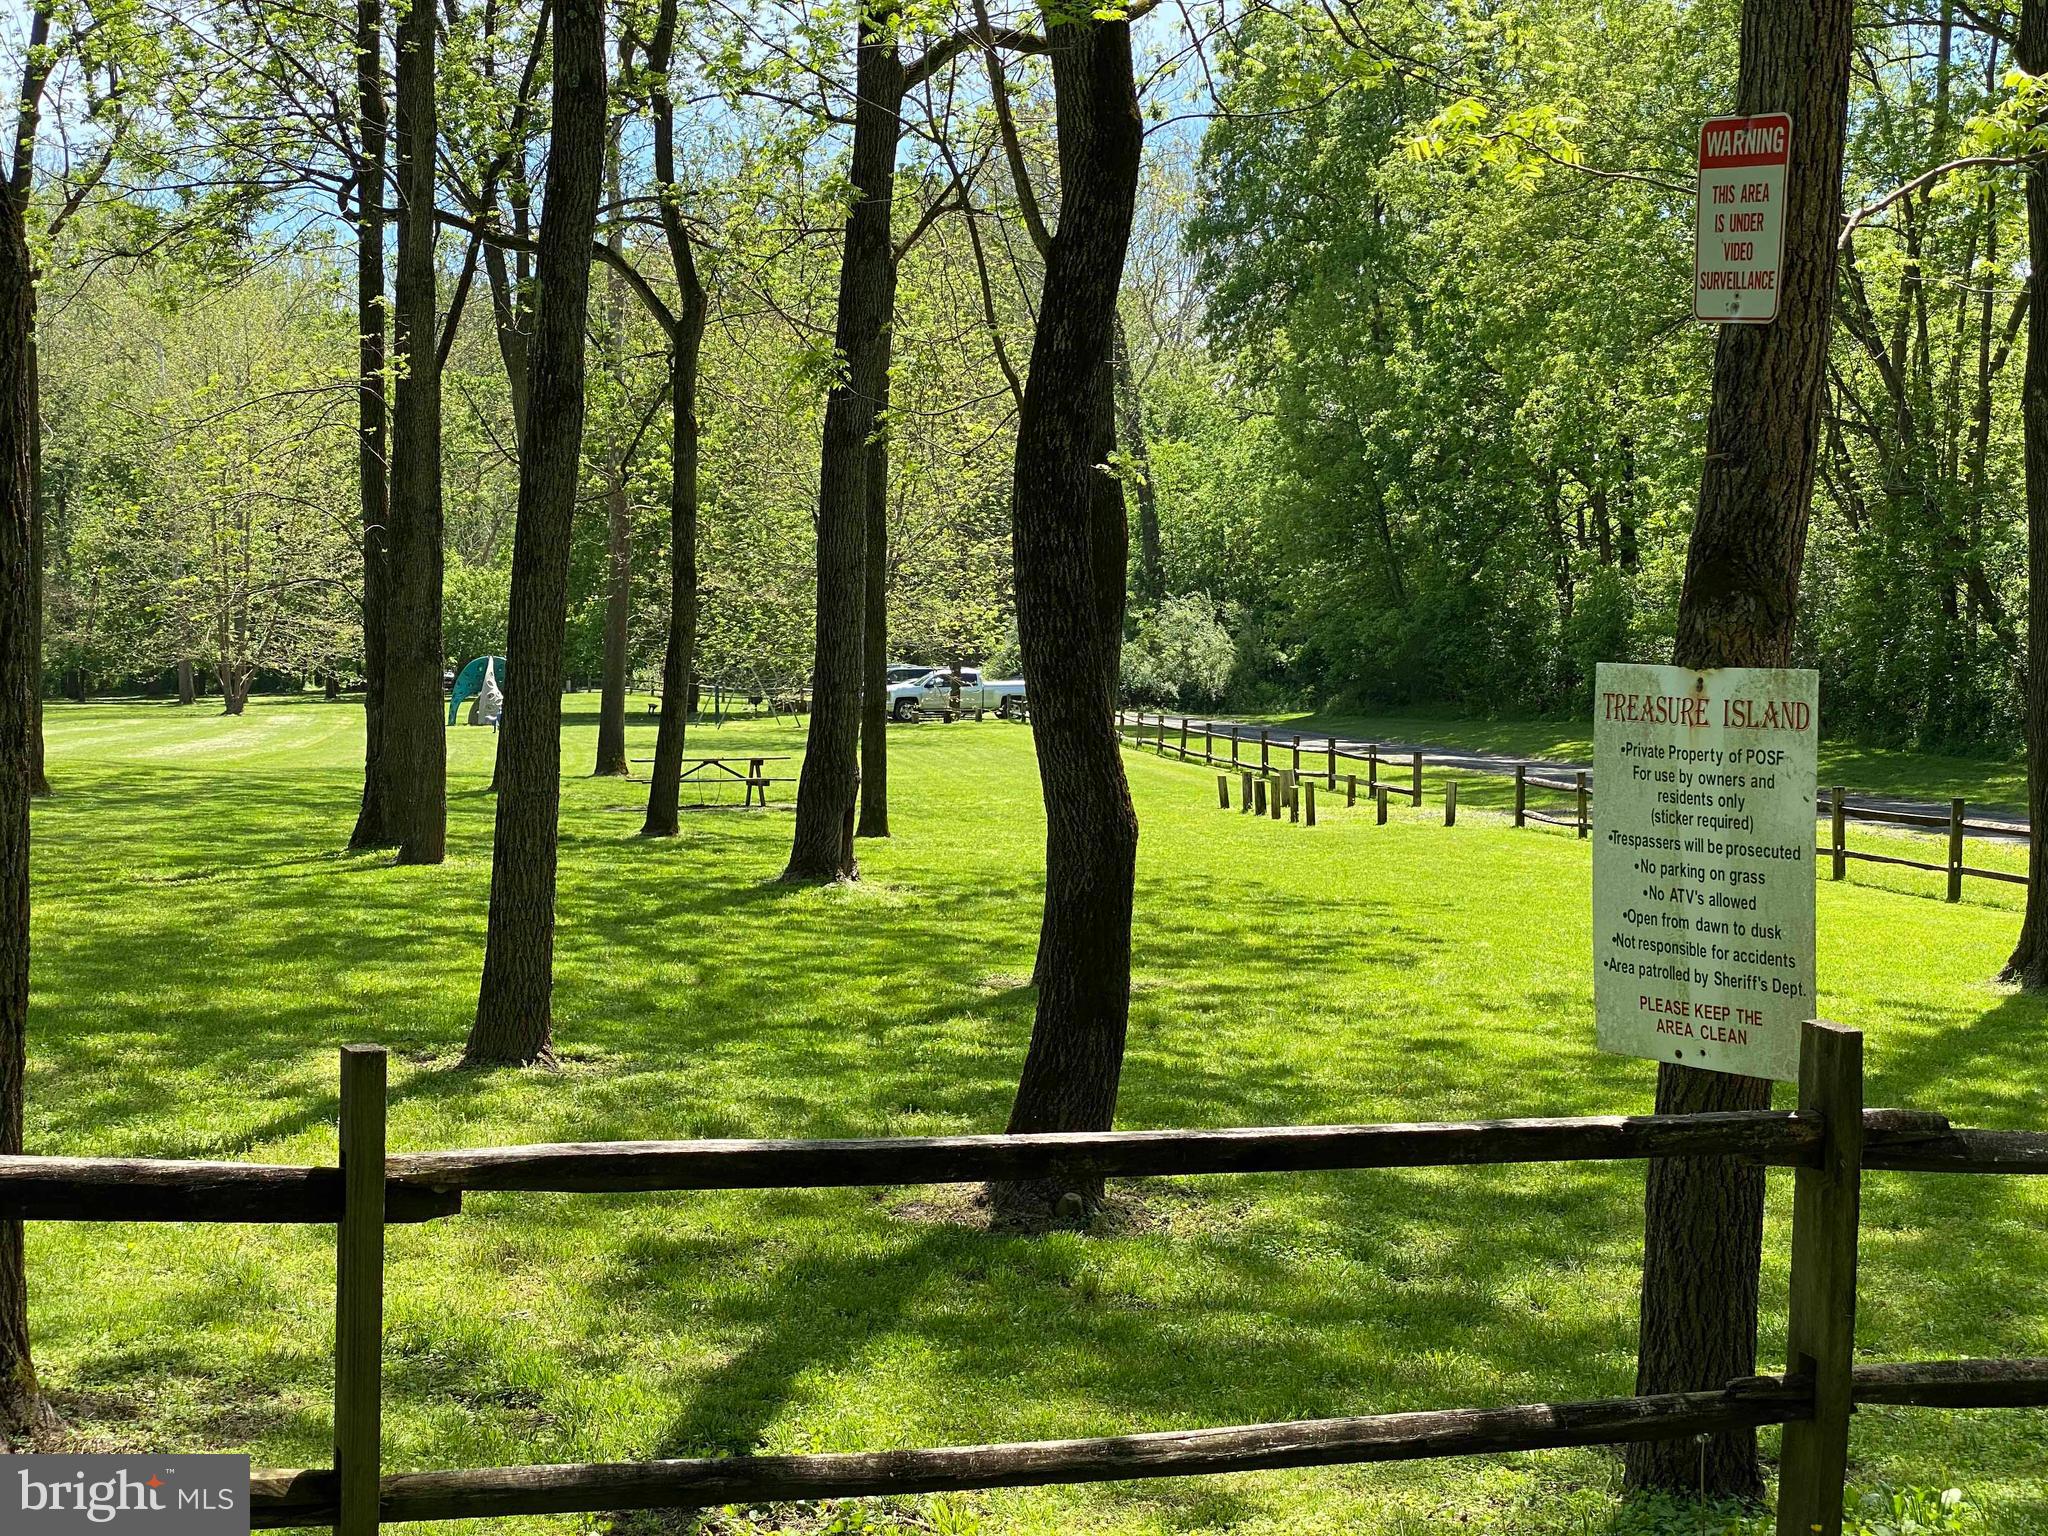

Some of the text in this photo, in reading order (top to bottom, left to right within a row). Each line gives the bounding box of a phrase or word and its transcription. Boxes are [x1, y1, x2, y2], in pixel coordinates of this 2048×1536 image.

[1706, 127, 1784, 157] WARNING
[1713, 183, 1769, 204] THIS AREA
[1715, 213, 1764, 232] IS UNDER
[1724, 242, 1753, 261] VIDEO
[1700, 271, 1775, 289] SURVEILLANCE
[1603, 693, 1810, 731] TREASURE ISLAND
[1626, 742, 1784, 766] Private Property of POSF
[1633, 766, 1775, 789] For use by owners and
[1658, 790, 1745, 812] residents only
[1651, 808, 1753, 834] (sticker required)
[1612, 830, 1800, 861] Trespassers will be prosecuted
[1641, 860, 1765, 885] No parking on grass
[1650, 885, 1756, 910] No ATV's allowed
[1628, 909, 1781, 940] Open from dawn to dusk
[1617, 933, 1795, 968] Not responsible for accidents
[1609, 958, 1807, 997] Area patrolled by Sheriff's Dept.
[1640, 996, 1762, 1026] PLEASE KEEP THE
[1657, 1019, 1747, 1045] AREA CLEAN
